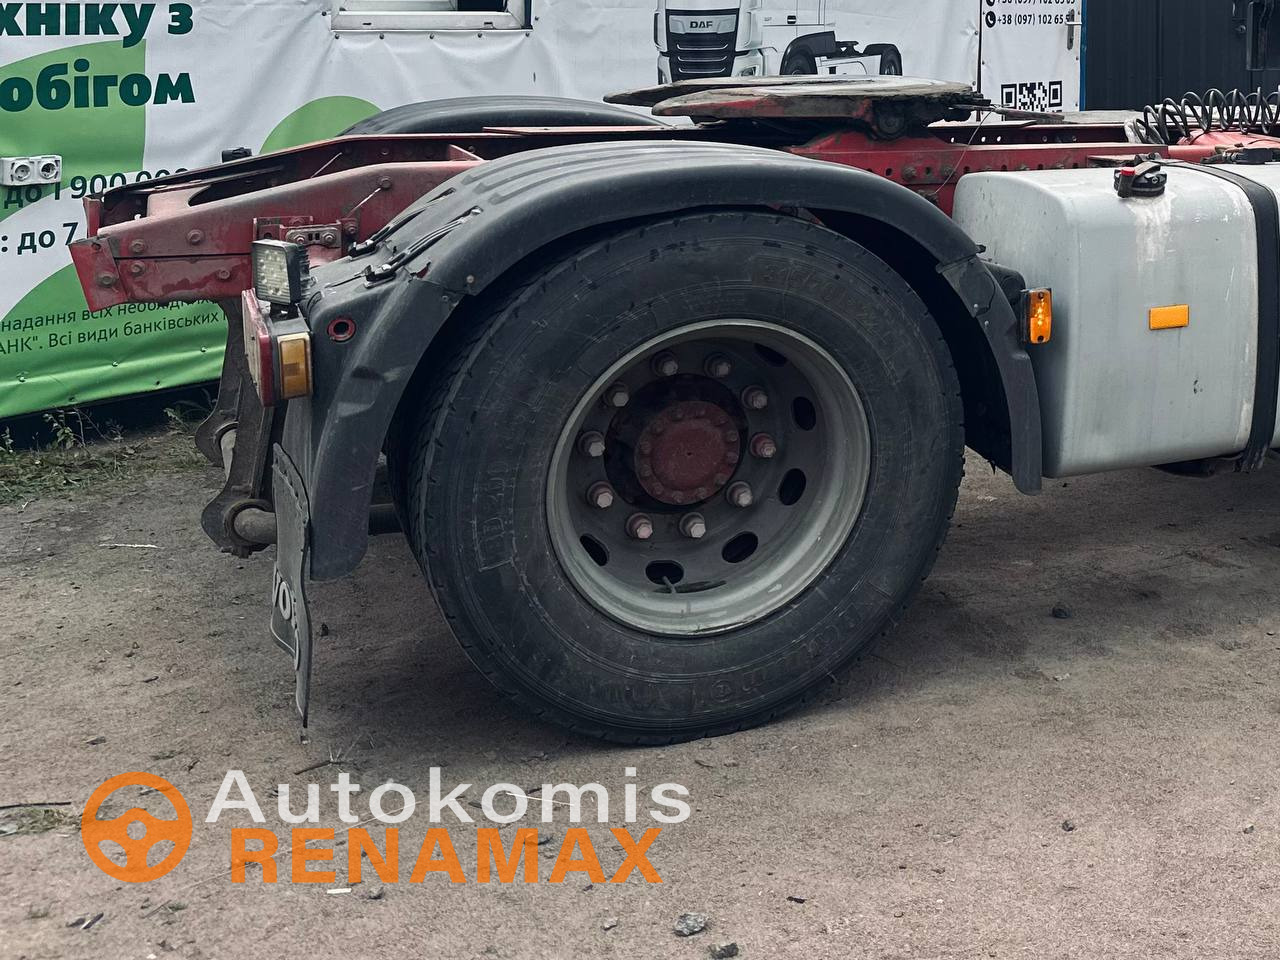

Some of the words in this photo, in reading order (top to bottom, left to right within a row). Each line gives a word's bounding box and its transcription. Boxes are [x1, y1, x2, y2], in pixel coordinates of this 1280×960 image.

[168, 3, 193, 34] з
[689, 21, 713, 29] DAF
[997, 14, 1012, 25] +38
[1014, 13, 1036, 26] (097)
[1038, 14, 1053, 25] 102
[1054, 14, 1064, 25] 65
[0, 58, 195, 112] обігом
[17, 230, 56, 256] до
[62, 222, 79, 246] 7
[1, 310, 76, 333] надання
[49, 331, 72, 348] Всі
[78, 327, 118, 344] види
[124, 312, 219, 337] банківських
